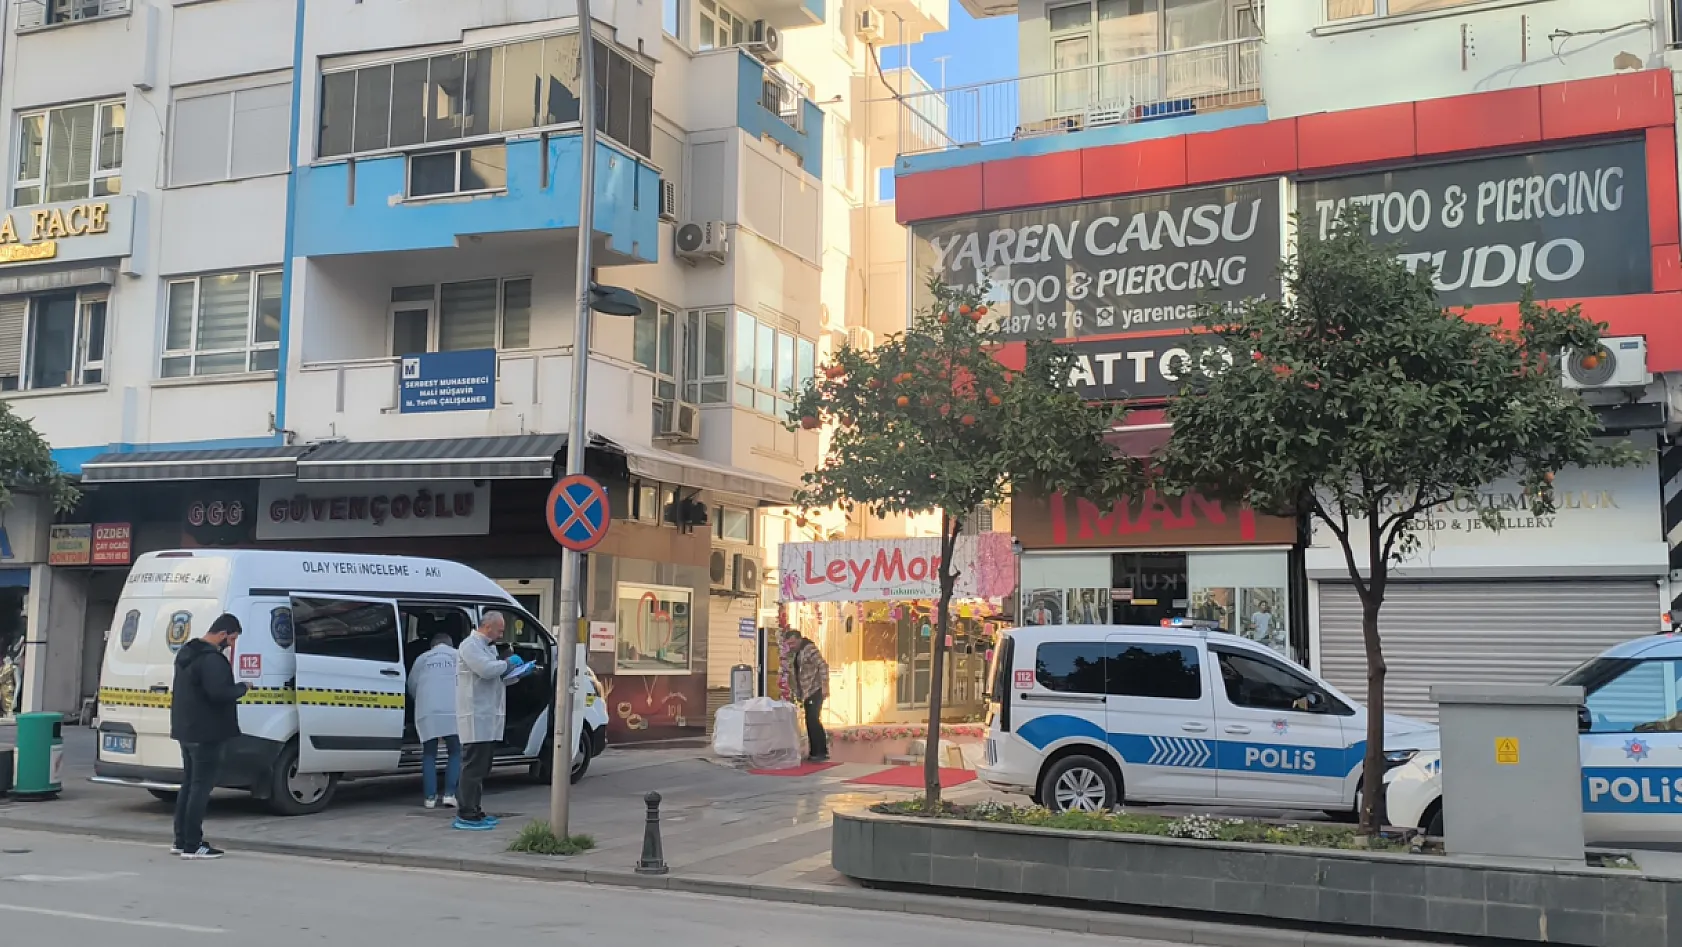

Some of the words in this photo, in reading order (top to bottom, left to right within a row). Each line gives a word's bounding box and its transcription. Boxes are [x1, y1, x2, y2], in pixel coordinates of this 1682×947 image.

[1441, 184, 1468, 229] &
[1477, 166, 1624, 226] PIERCING
[31, 202, 109, 240] FACE
[929, 221, 1080, 274] YAREN
[1084, 199, 1261, 256] CANSU
[1388, 238, 1585, 291] TUDIO
[1066, 272, 1092, 300] &
[1097, 256, 1247, 298] PIERCING
[1036, 311, 1058, 333] 94
[1061, 309, 1084, 330] 76
[405, 379, 439, 389] SERBEST
[440, 375, 489, 387] MUHASEBECİ
[420, 388, 438, 397] MALİ
[439, 385, 474, 396] MÜŞAVİR
[439, 395, 487, 407] ÇALIŞKANER
[188, 500, 243, 527] GGG
[269, 489, 476, 526] GÜVENÇOĞLU
[96, 525, 130, 539] ÖZDEN
[302, 561, 331, 574] OLAY
[241, 656, 259, 668] 112
[1016, 671, 1031, 682] 112
